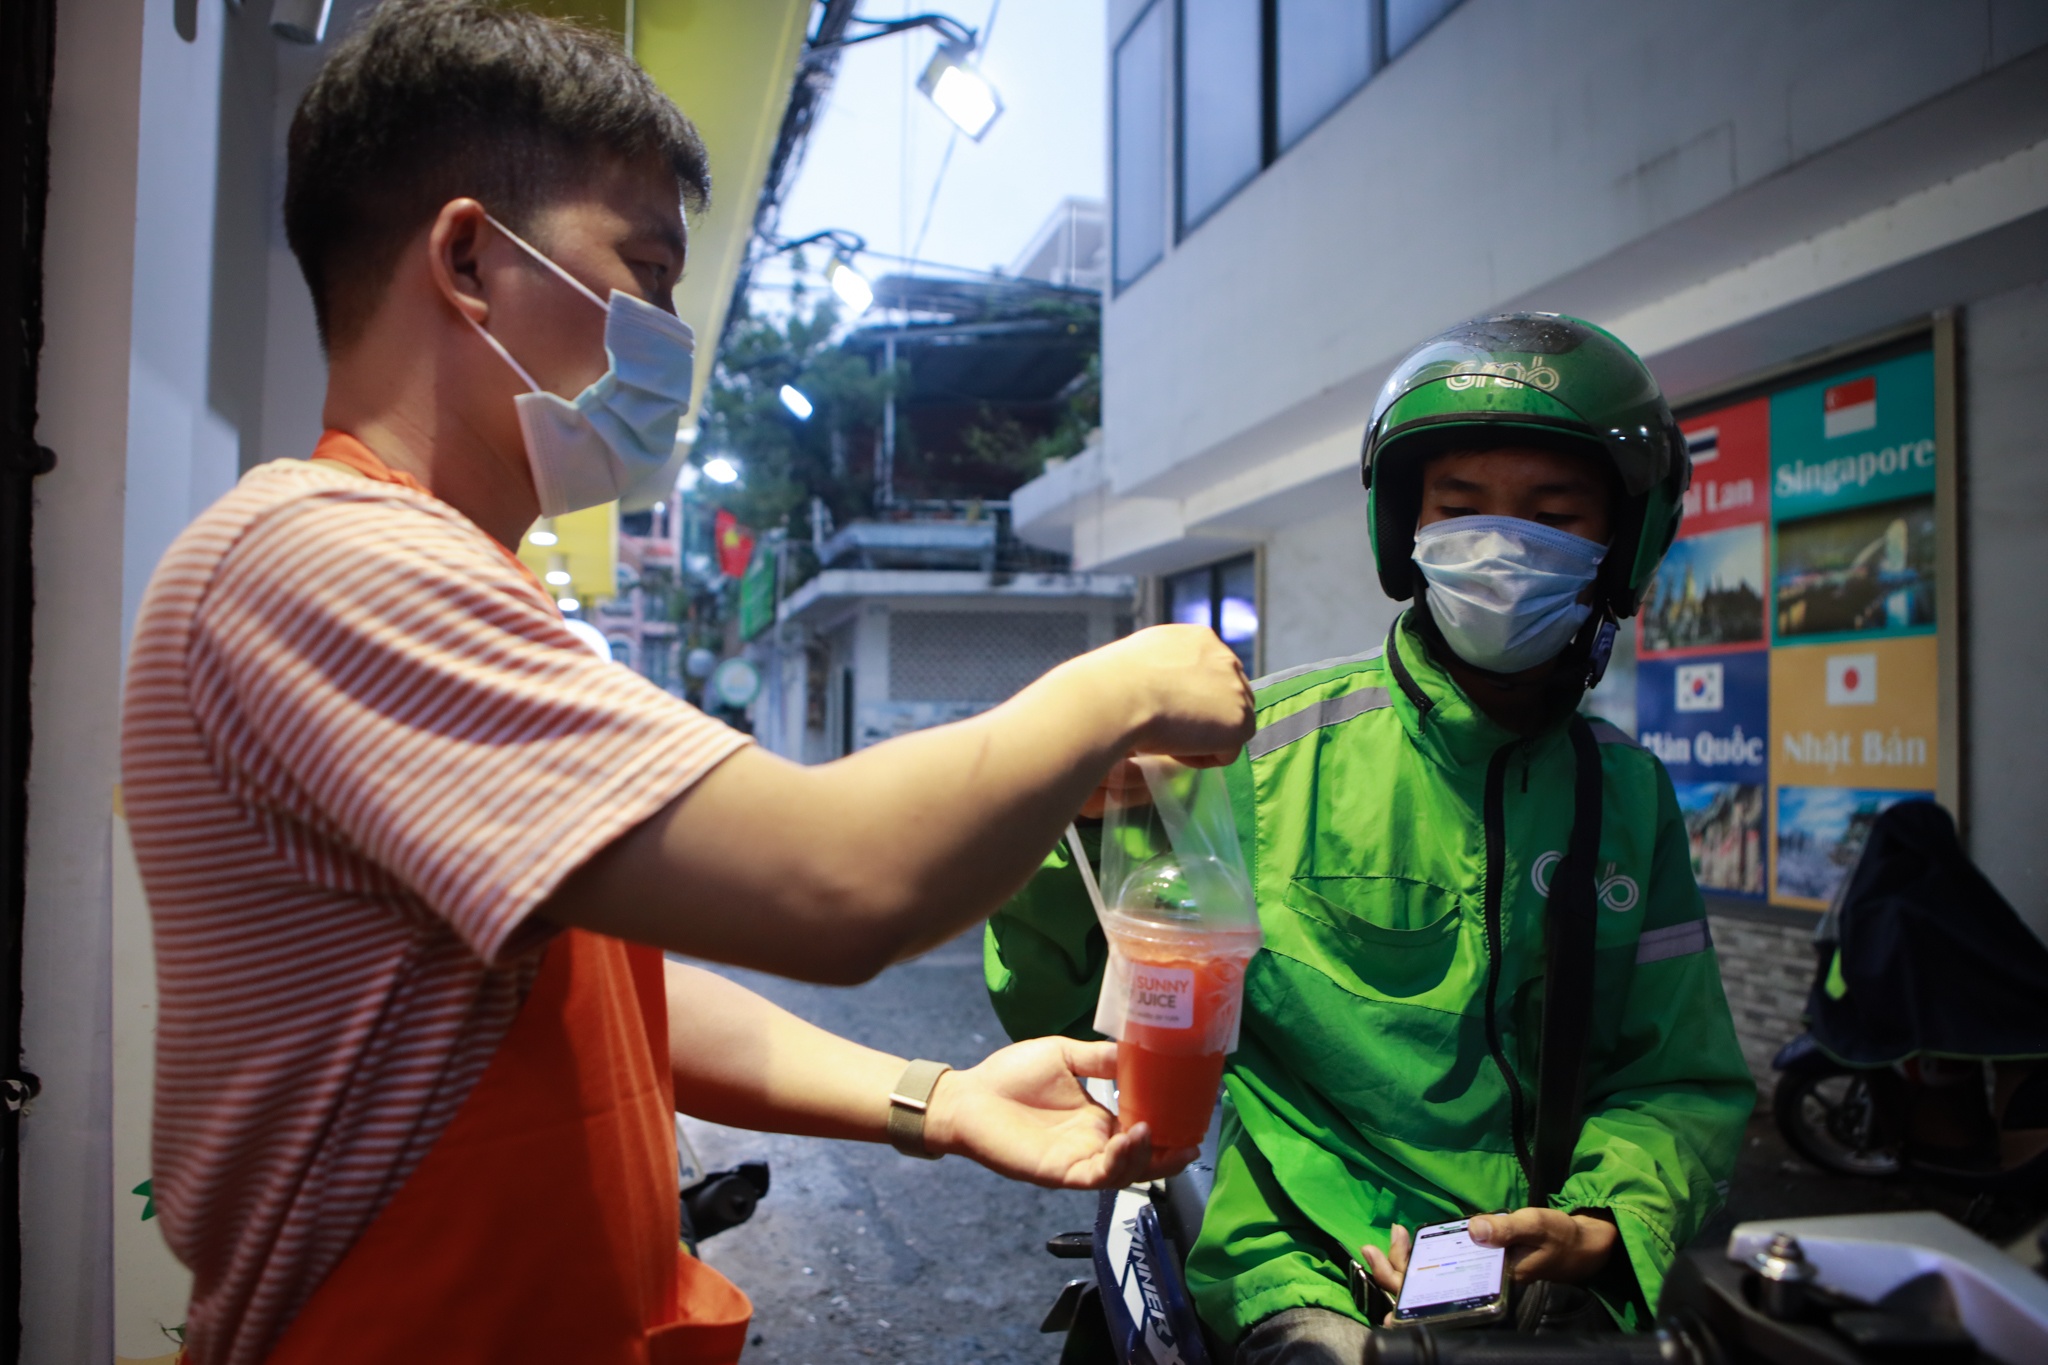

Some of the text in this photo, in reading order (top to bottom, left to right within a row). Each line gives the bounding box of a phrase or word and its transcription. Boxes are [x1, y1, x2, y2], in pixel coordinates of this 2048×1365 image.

[1446, 356, 1560, 391] Grab
[1775, 438, 1935, 498] Singapore
[1705, 478, 1755, 514] Lan
[1137, 975, 1190, 994] SUNNY
[1137, 991, 1177, 1009] JUICE
